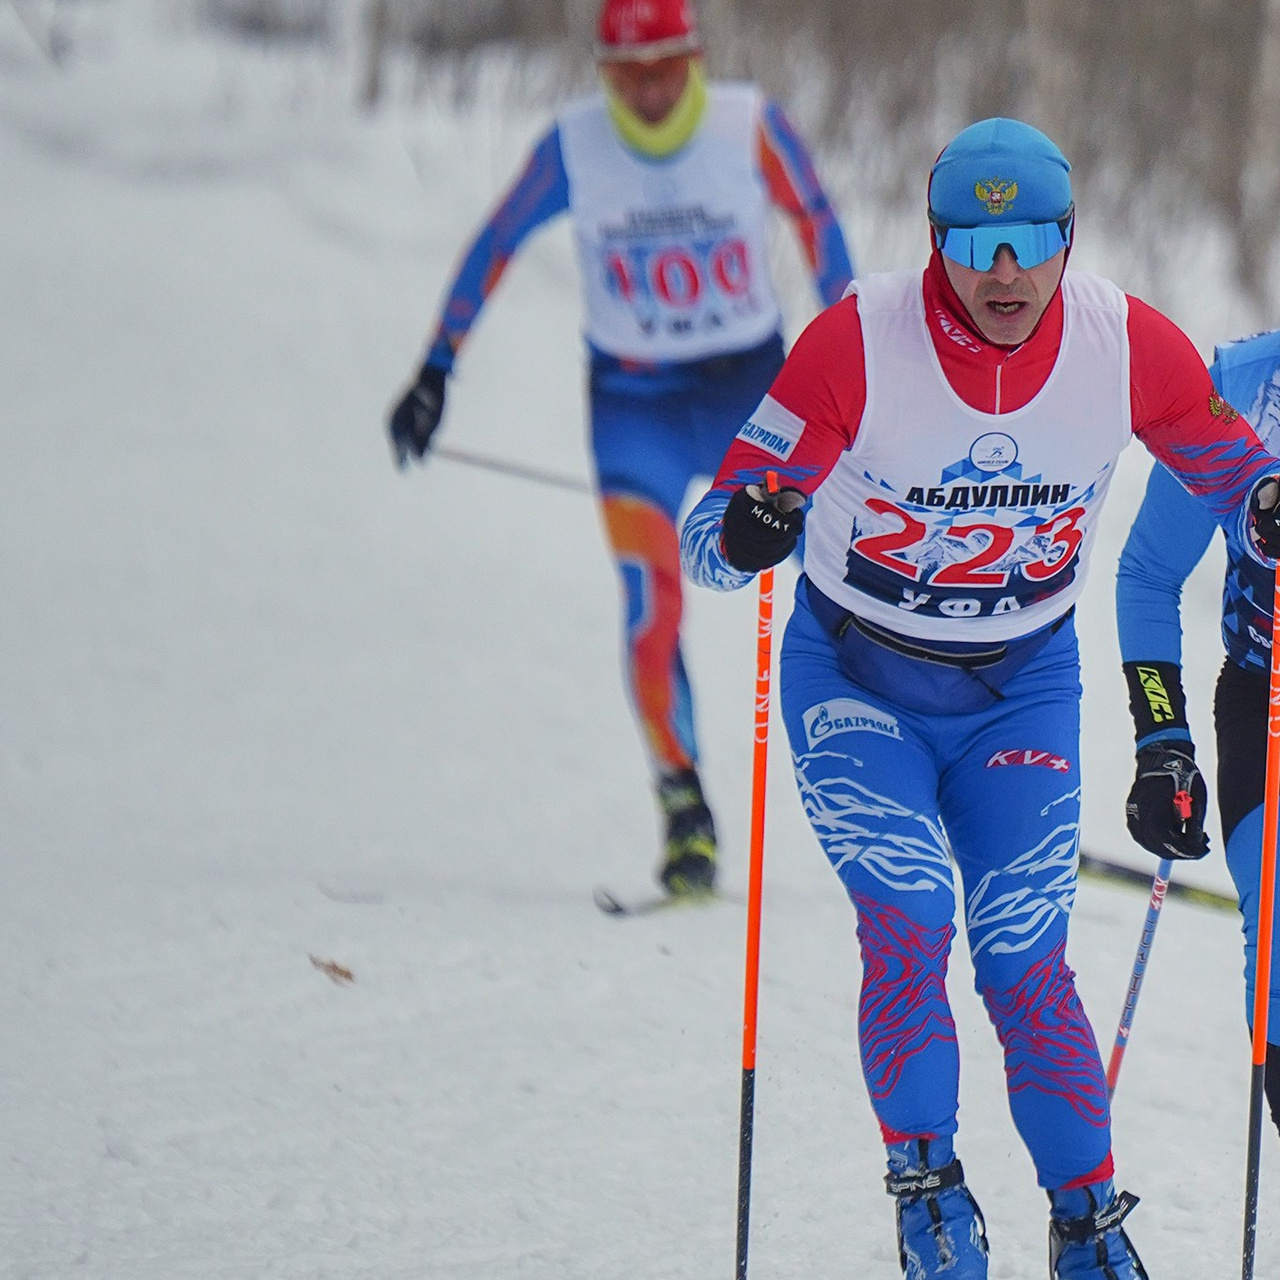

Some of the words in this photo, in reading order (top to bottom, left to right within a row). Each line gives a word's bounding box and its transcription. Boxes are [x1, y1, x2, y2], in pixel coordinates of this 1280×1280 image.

[741, 421, 790, 455] GAZPROM
[904, 483, 1071, 510] АБДУЛЛИН
[852, 497, 1087, 588] 223
[897, 588, 1022, 617] УФА
[834, 717, 895, 734] GAZPROM
[986, 750, 1070, 773] KV+
[890, 1175, 942, 1194] SPINE
